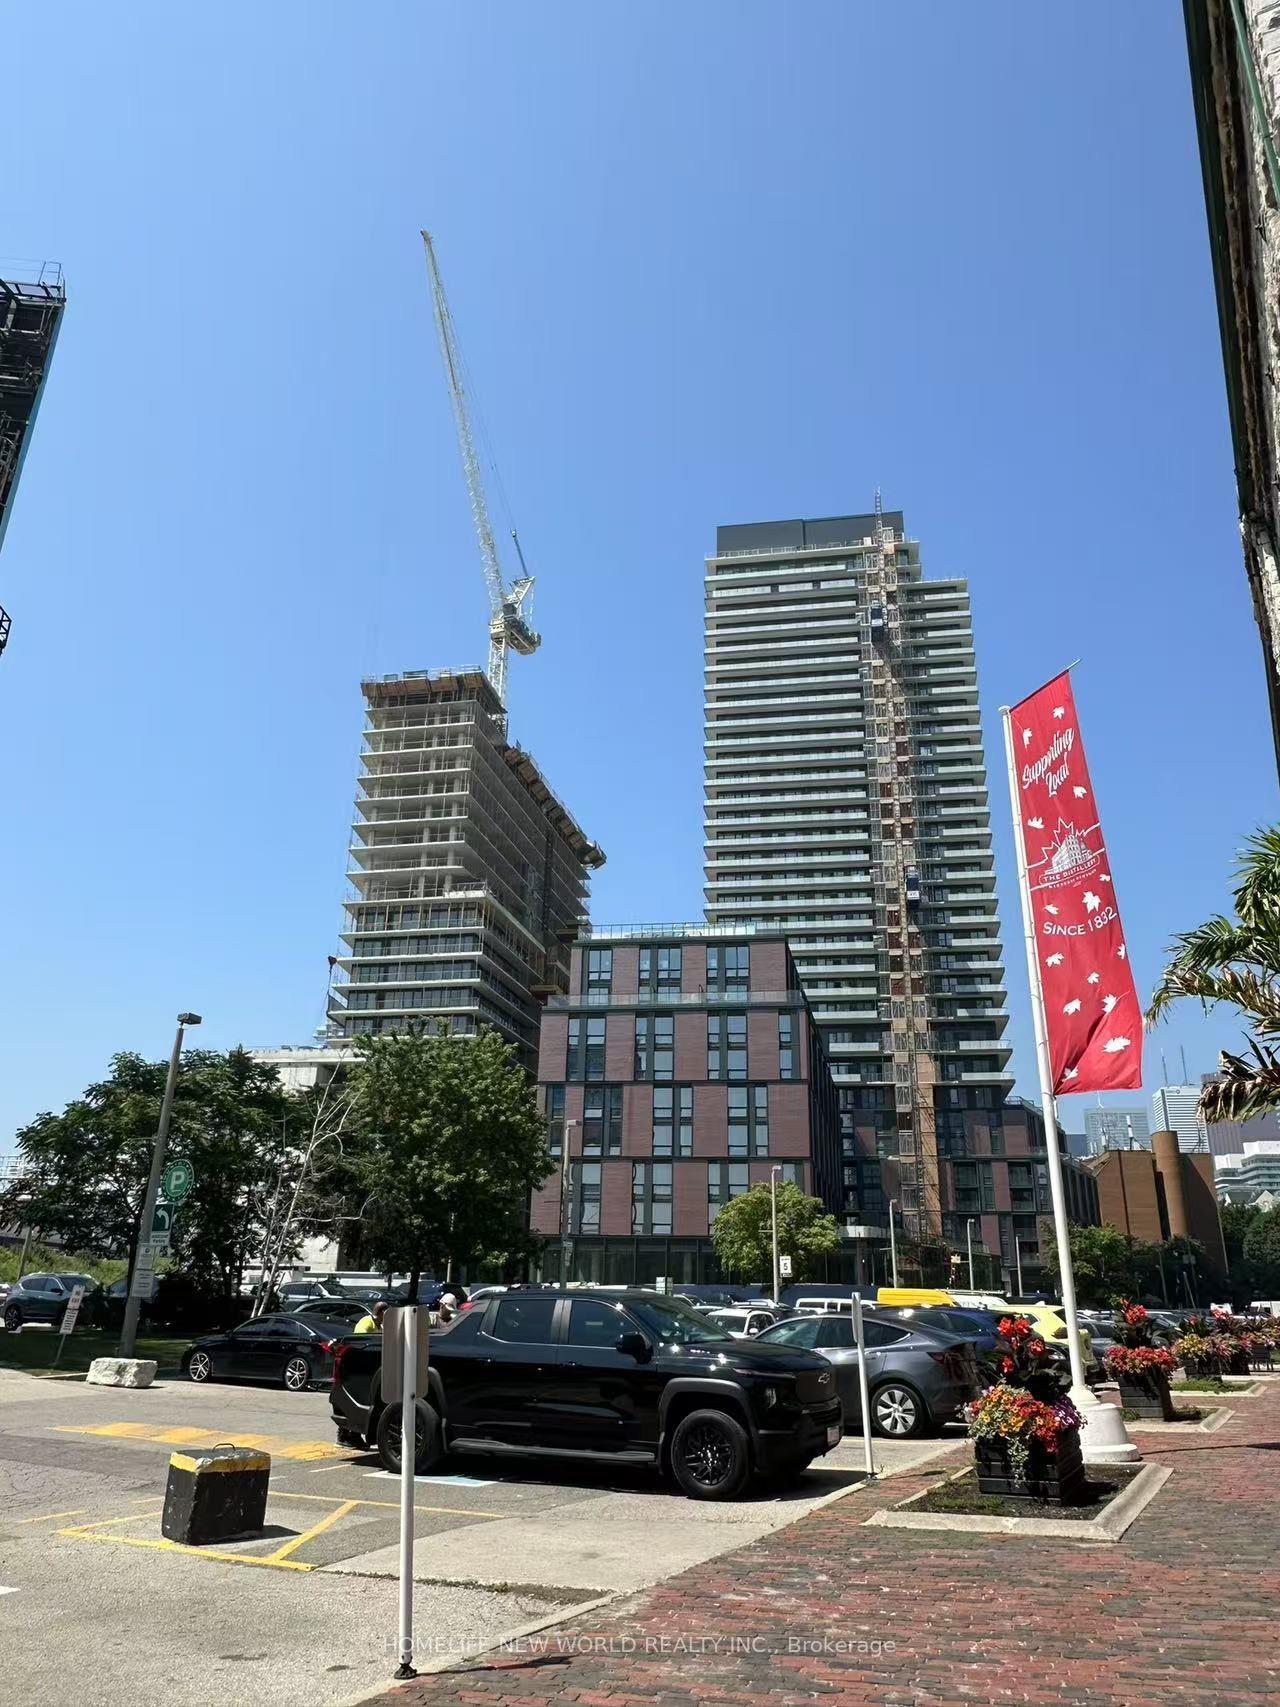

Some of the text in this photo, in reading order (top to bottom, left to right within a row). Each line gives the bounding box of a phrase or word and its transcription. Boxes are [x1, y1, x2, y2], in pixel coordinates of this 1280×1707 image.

[1022, 727, 1075, 790] Supporting
[1045, 751, 1070, 798] Local
[1043, 873, 1062, 882] THE
[1043, 906, 1118, 936] SINCE 1832
[170, 1170, 186, 1191] P
[783, 1262, 789, 1271] 5
